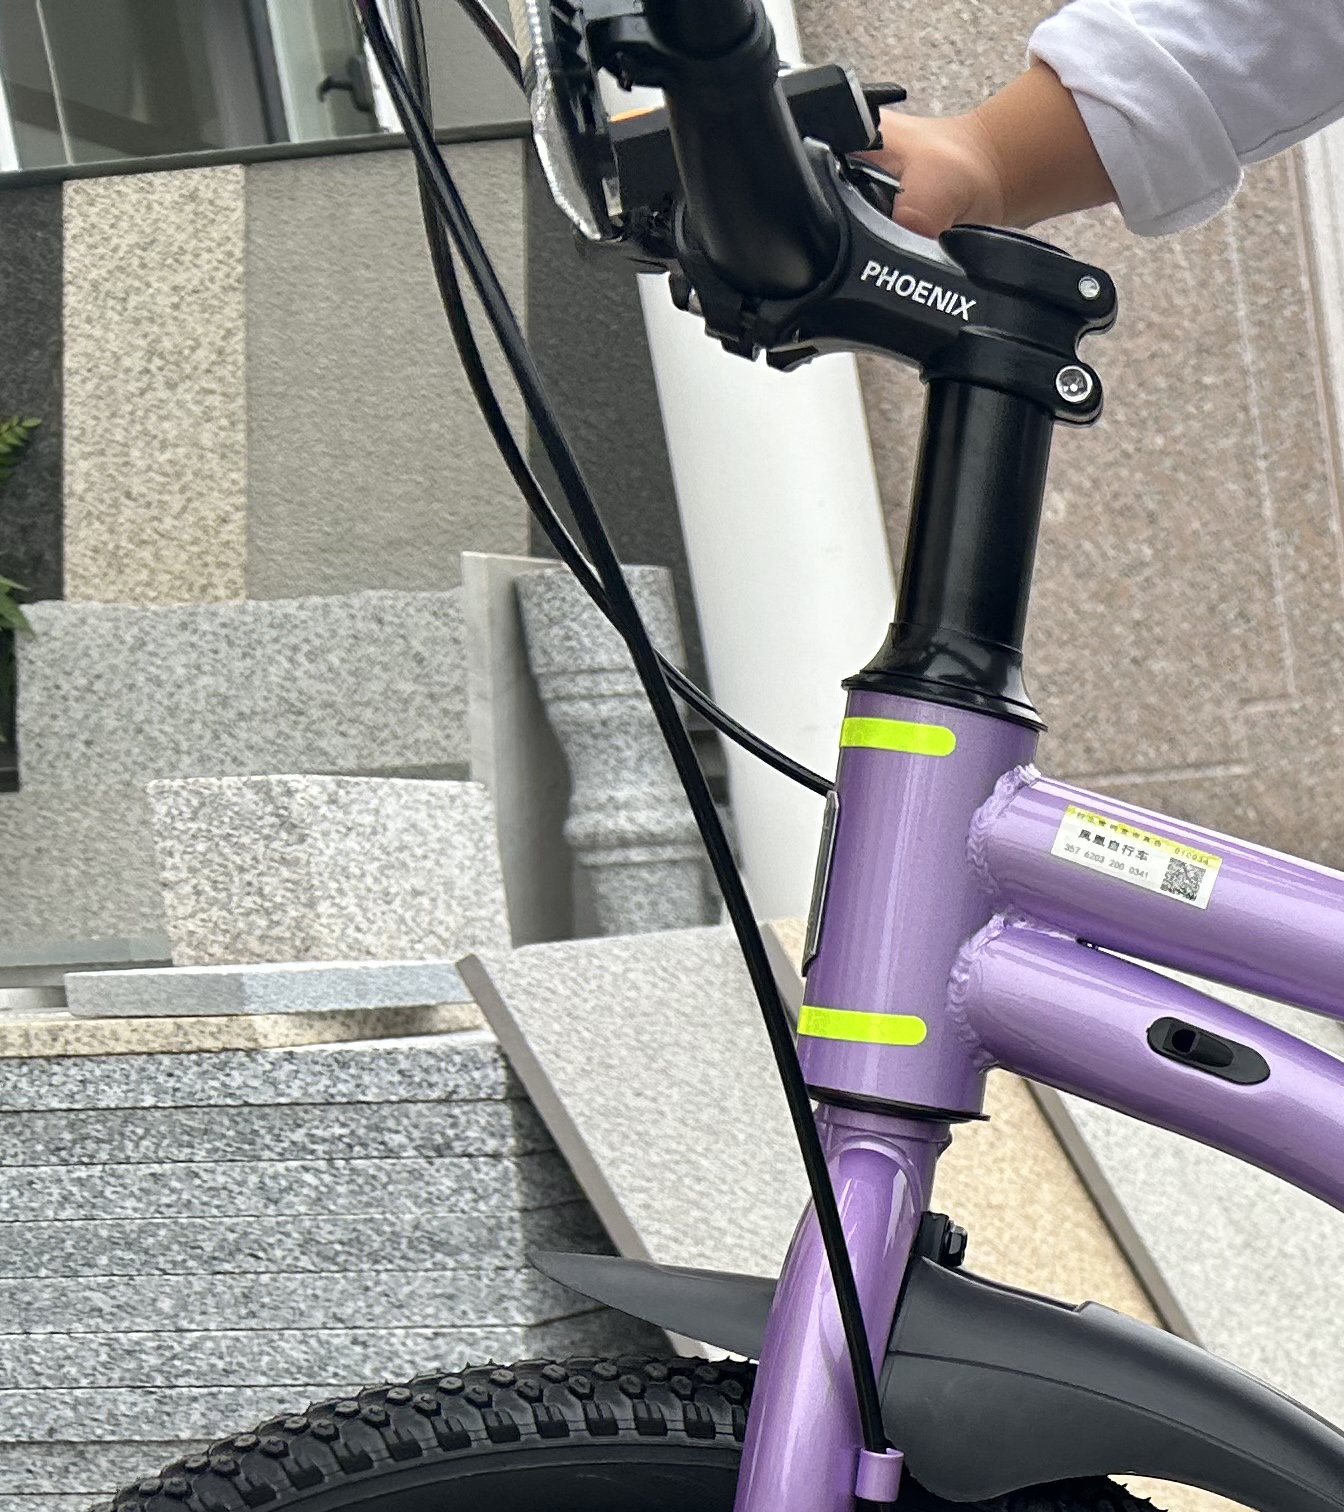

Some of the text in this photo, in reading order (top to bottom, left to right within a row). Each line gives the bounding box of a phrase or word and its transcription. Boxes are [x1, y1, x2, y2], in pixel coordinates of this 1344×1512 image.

[860, 260, 977, 321] PHOENIX
[1078, 829, 1150, 862] 凤凰自行车
